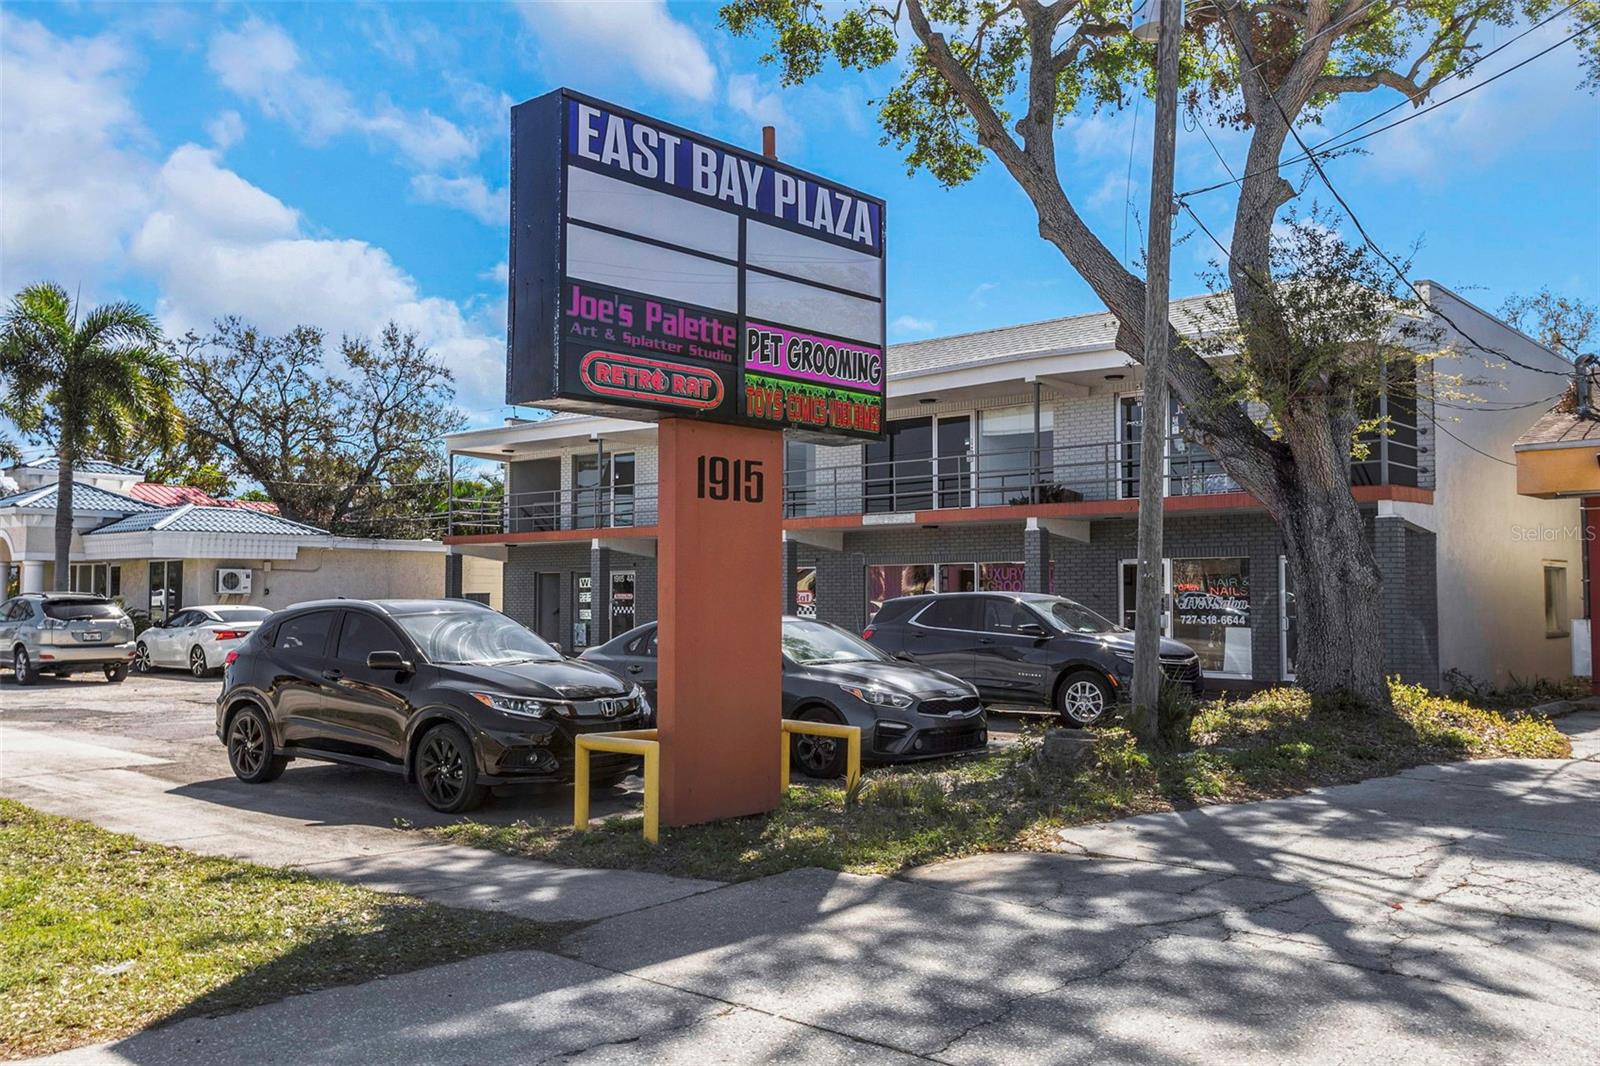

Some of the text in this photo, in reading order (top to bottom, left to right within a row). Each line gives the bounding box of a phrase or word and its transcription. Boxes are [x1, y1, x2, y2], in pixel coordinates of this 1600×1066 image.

[577, 103, 874, 246] EAST BAY PLAZA
[566, 285, 736, 348] Joe's Palette
[570, 322, 732, 362] Art & Splatter Studio
[746, 328, 881, 385] PET GROOMING
[594, 361, 713, 399] RETRO RAT
[697, 455, 764, 503] 1915
[1177, 583, 1200, 592] OPEN
[1207, 577, 1237, 586] HAIR
[1209, 587, 1248, 596] NAILS
